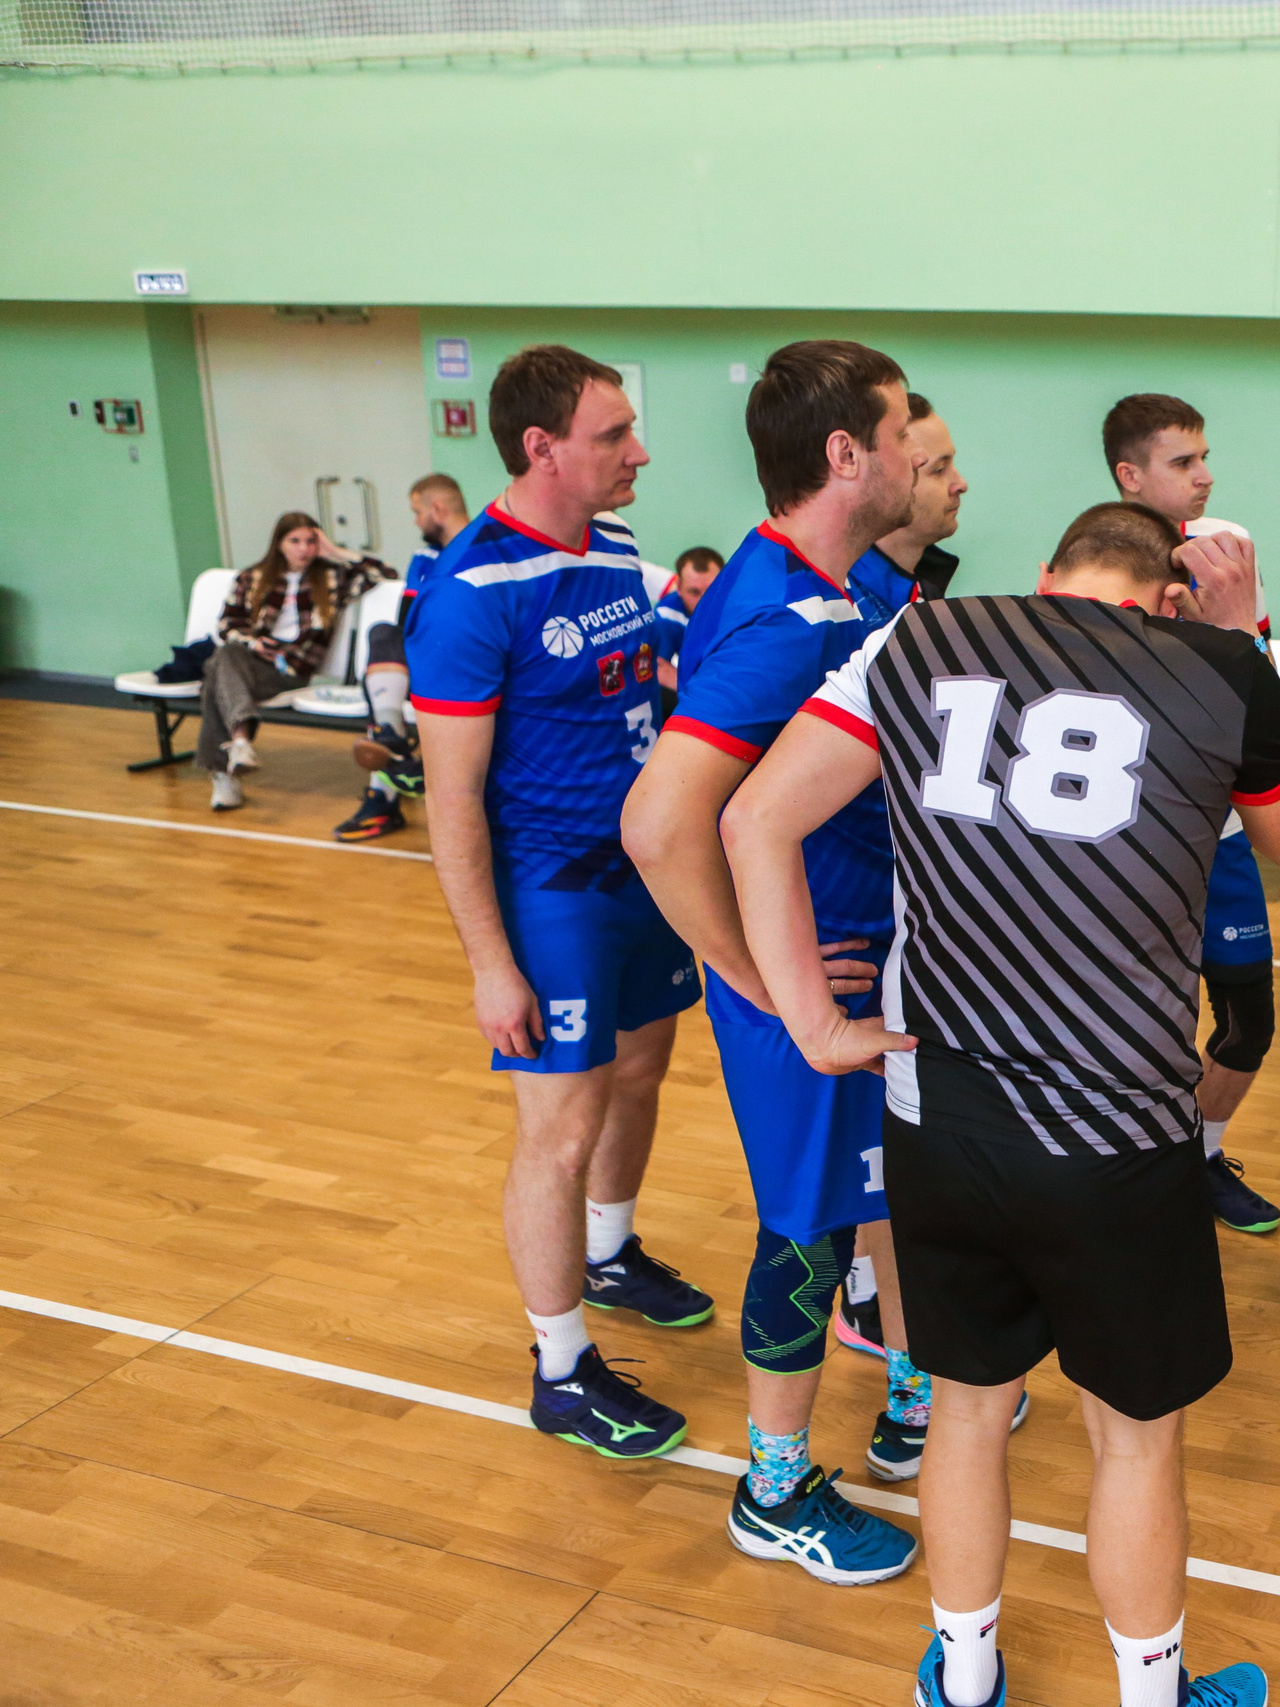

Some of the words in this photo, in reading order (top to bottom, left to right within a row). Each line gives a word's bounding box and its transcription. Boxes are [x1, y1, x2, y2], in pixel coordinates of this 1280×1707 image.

[578, 595, 639, 631] РОССЕТИ
[589, 615, 644, 647] МОСКОВСКИЙ
[624, 700, 658, 764] 3
[919, 676, 1148, 842] 18
[549, 999, 587, 1042] 3
